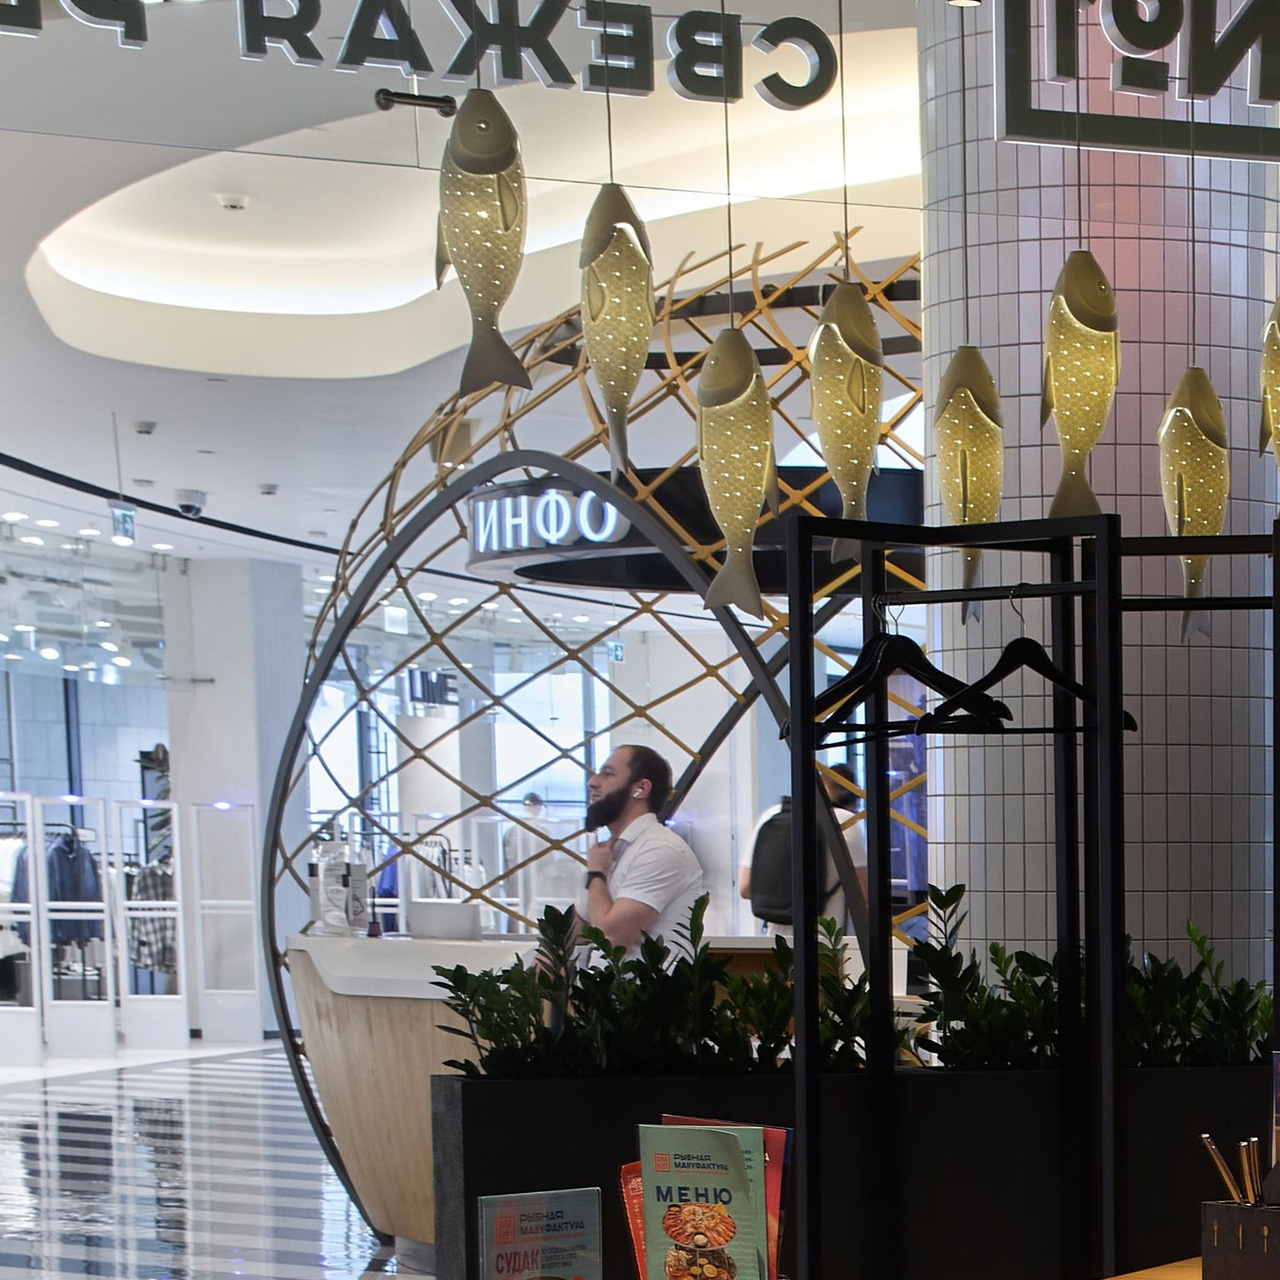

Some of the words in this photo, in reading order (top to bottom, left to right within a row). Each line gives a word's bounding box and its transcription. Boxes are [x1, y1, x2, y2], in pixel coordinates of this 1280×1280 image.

[475, 489, 619, 552] ИНФО
[674, 1153, 711, 1162] РЫБНАЯ
[674, 1161, 729, 1171] МАНУФАКТУРА
[655, 1185, 733, 1206] МЕНЮ
[520, 1211, 564, 1224] РЫБНАЯ
[520, 1220, 586, 1236] МАНУФАКТУРА
[495, 1249, 540, 1275] СУДАК
